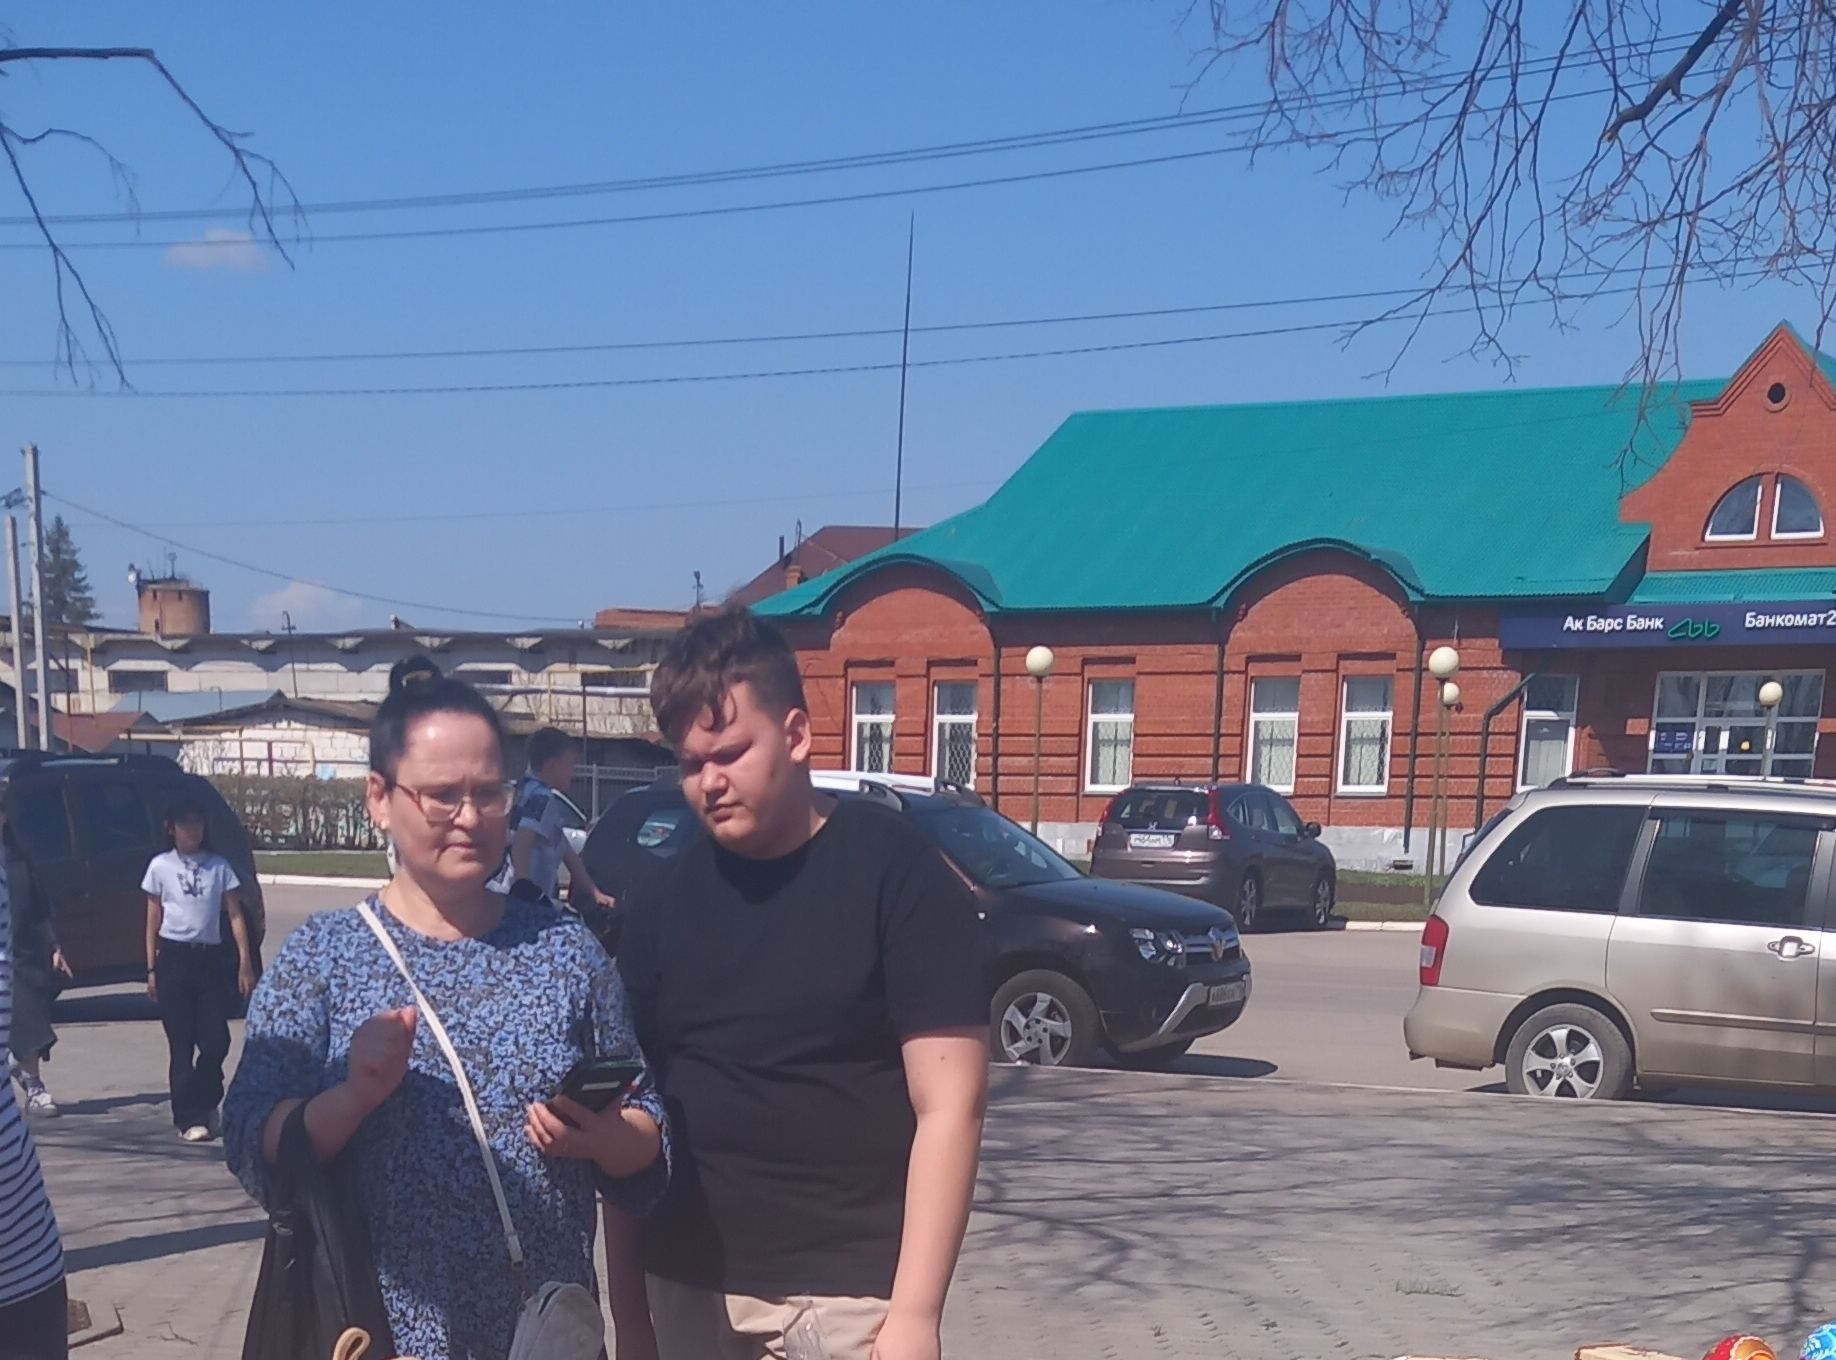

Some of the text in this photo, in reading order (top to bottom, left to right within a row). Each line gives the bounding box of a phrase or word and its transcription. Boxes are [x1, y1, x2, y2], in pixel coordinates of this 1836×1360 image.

[1563, 614, 1664, 633] Ак Барс Банк
